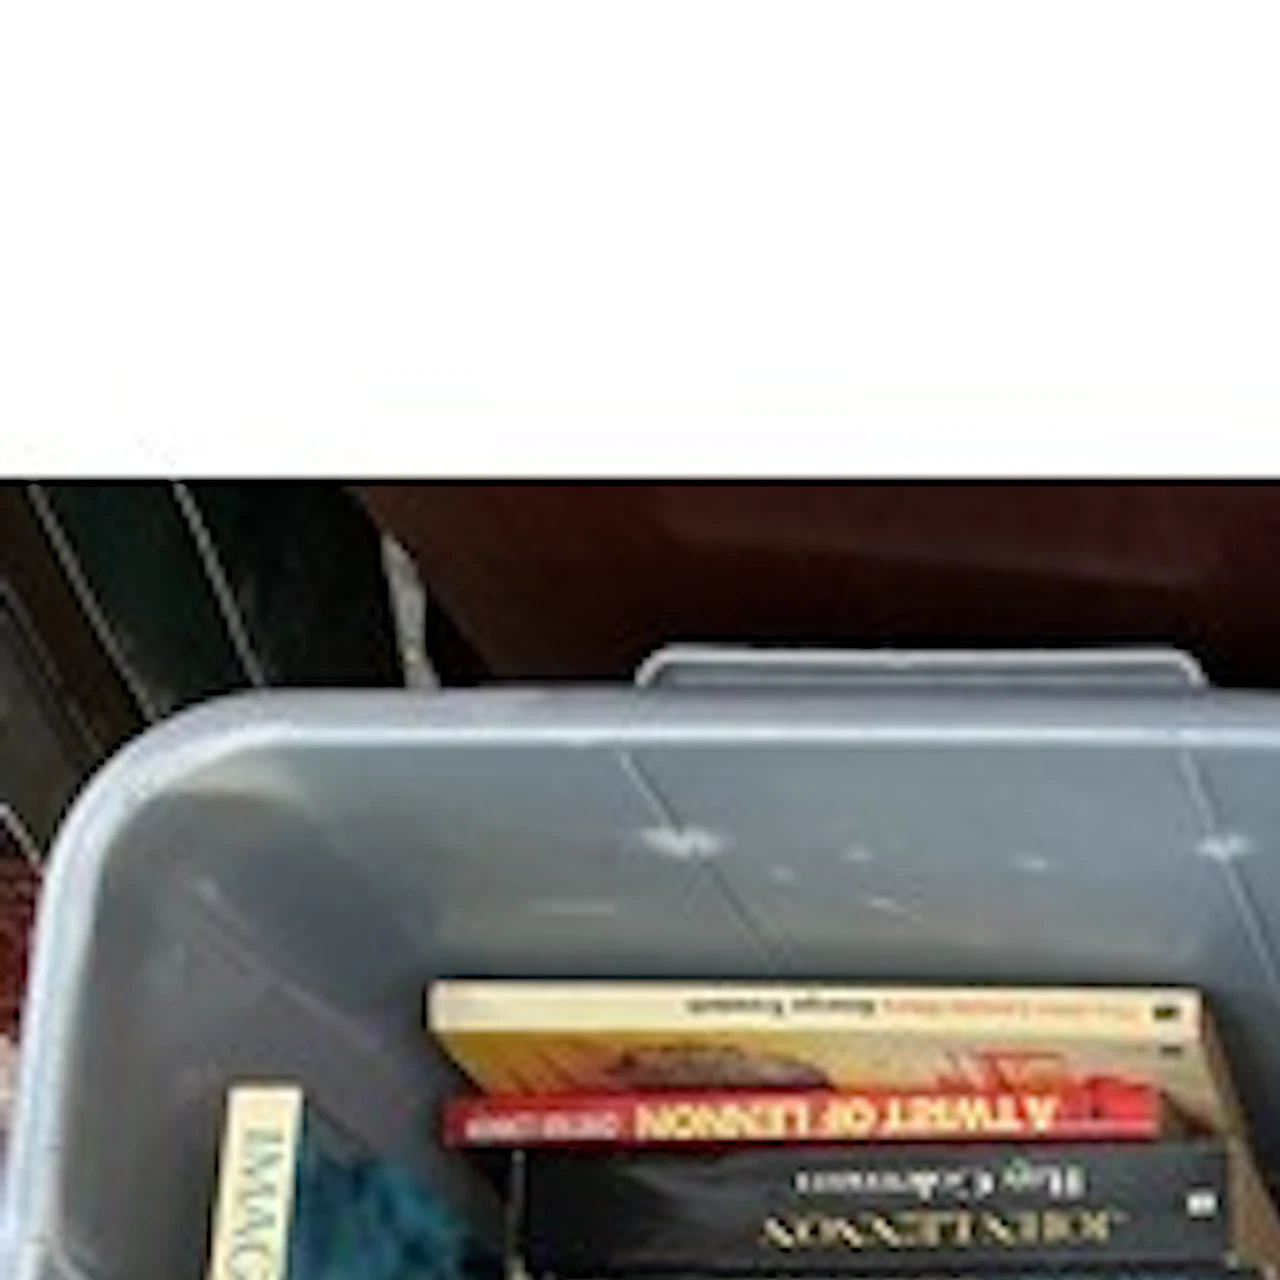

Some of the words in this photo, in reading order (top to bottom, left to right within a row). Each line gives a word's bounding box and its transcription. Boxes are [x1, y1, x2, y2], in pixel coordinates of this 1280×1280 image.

[635, 1099, 810, 1142] LENNON
[822, 1096, 878, 1138] OF
[1023, 1095, 1059, 1134] A
[765, 1213, 972, 1249] LENNON
[981, 1211, 1116, 1249] JOHN
